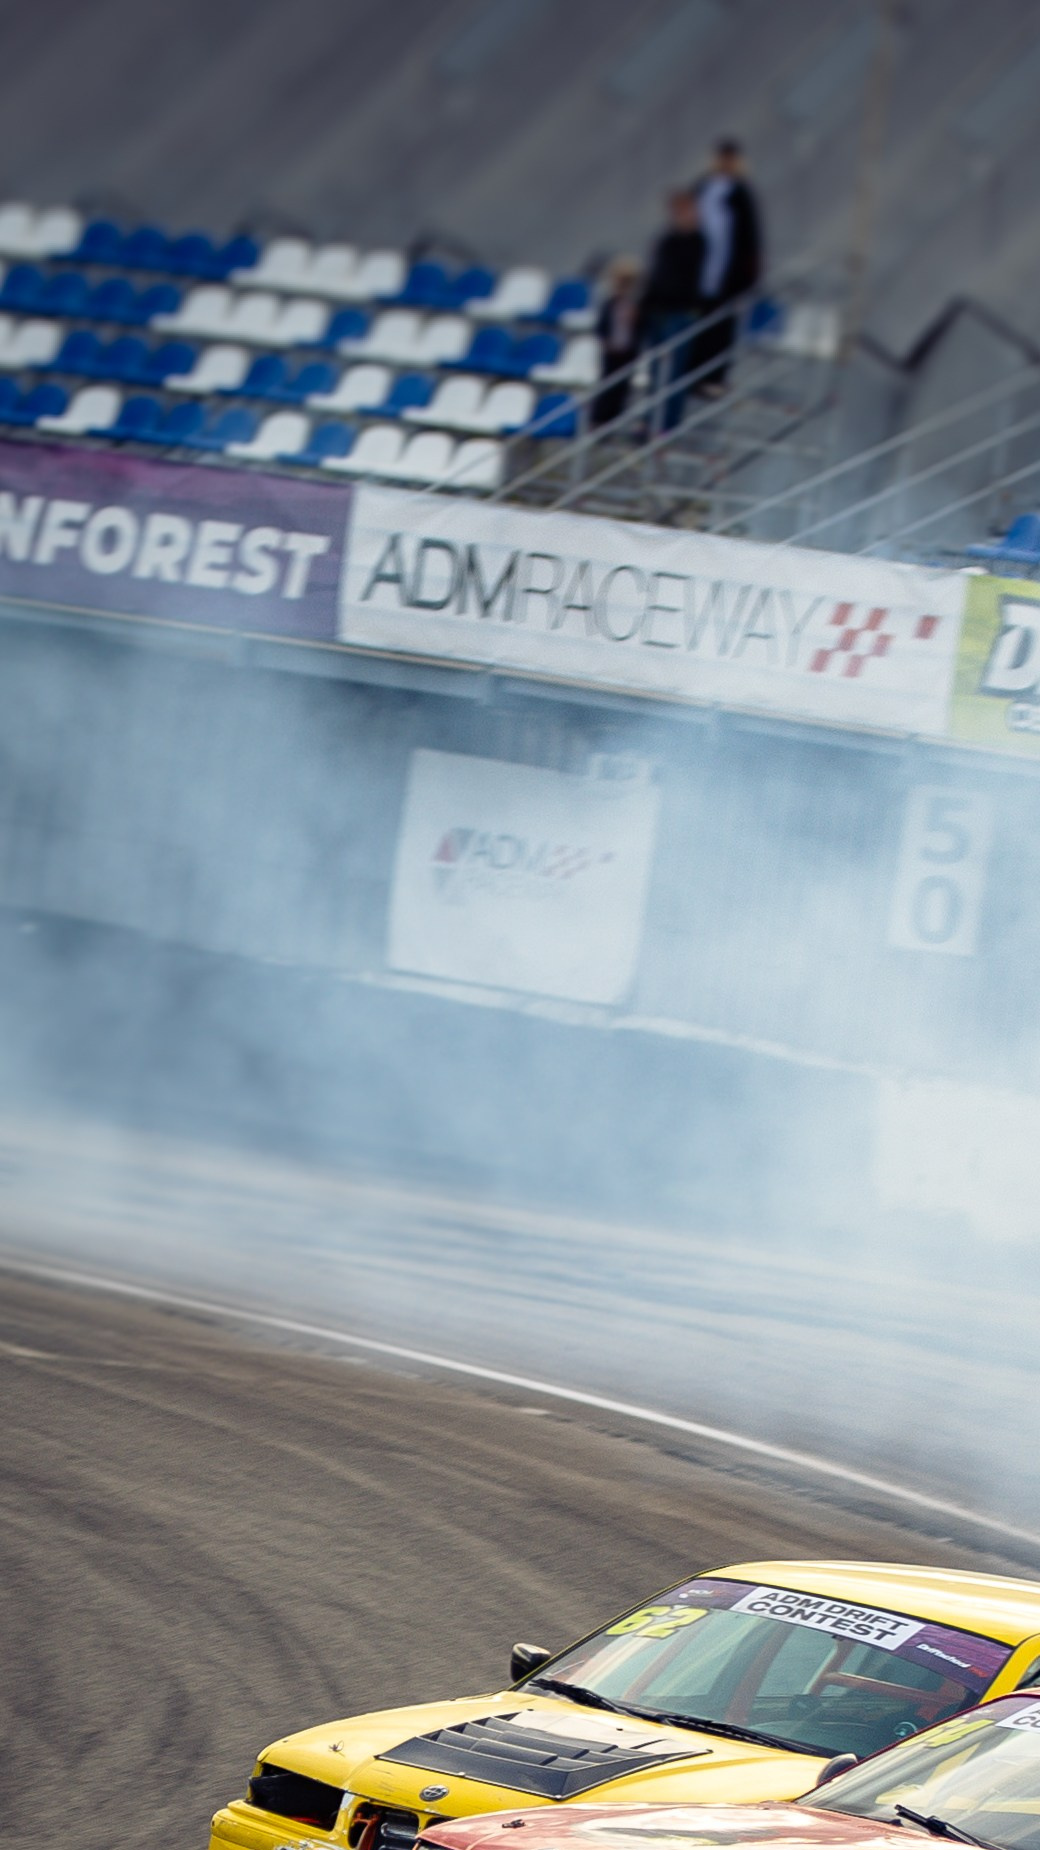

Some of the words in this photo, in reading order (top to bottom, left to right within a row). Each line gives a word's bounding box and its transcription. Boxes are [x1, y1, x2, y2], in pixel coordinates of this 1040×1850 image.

[605, 1605, 709, 1639] 62
[746, 1601, 897, 1642] CONTEST
[758, 1591, 824, 1610] ADM
[825, 1601, 910, 1631] DRIFT
